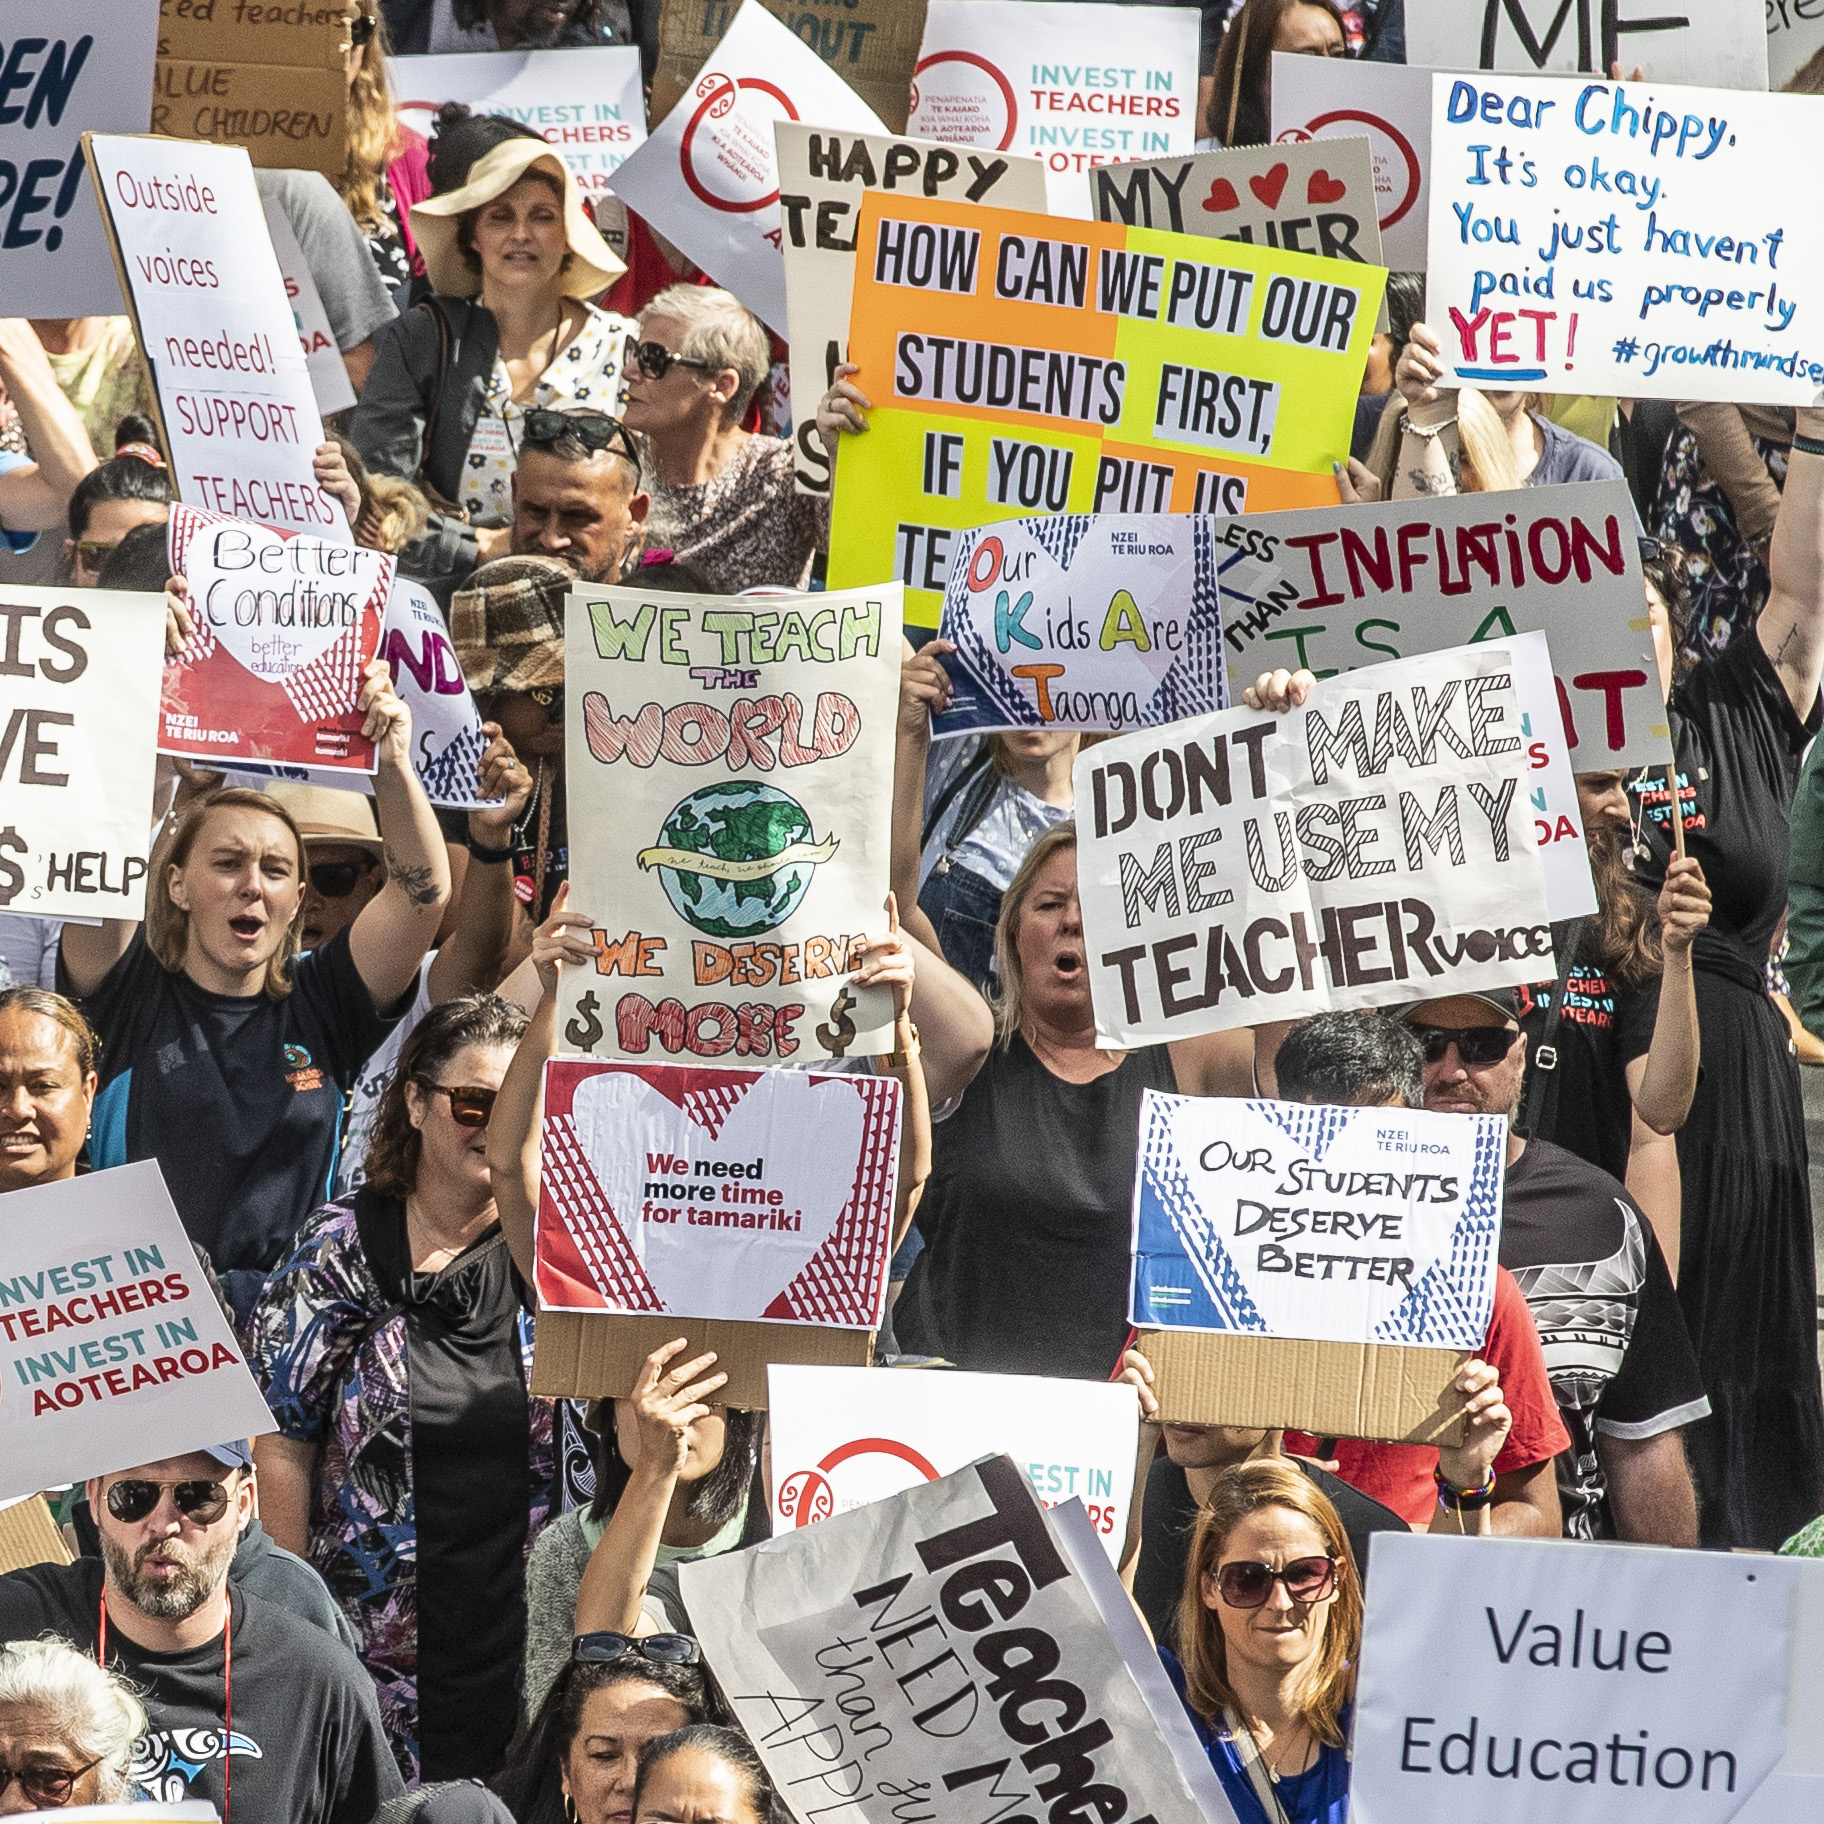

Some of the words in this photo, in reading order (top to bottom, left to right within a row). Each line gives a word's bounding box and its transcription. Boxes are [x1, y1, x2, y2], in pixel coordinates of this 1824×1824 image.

[1447, 80, 1555, 128] Dear
[1466, 143, 1538, 190] It's
[1453, 205, 1521, 248] You
[1540, 211, 1622, 261] just
[1642, 207, 1783, 270] haven't
[1472, 267, 1555, 315] paid
[1575, 274, 1615, 300] us
[1638, 281, 1797, 336] properly
[1449, 307, 1579, 370] YET!
[213, 528, 369, 576] Better
[965, 536, 1037, 593] Our
[208, 578, 357, 630] Conditions
[993, 589, 1091, 652] Kids
[1098, 591, 1180, 650] Are
[251, 638, 303, 658] better
[251, 658, 303, 677] education
[1011, 664, 1141, 724] Taonga
[1201, 1142, 1275, 1174] OUR
[1377, 1130, 1408, 1142] NZEI
[1377, 1142, 1394, 1155] TE
[1396, 1142, 1420, 1155] RIU
[1422, 1142, 1450, 1155] ROA
[646, 1153, 688, 1174] We
[694, 1157, 763, 1179] need
[1276, 1160, 1459, 1203] STUDENTS
[644, 1179, 715, 1201] more
[721, 1183, 783, 1206] time
[642, 1203, 681, 1223] for
[687, 1204, 801, 1232] tamariki
[1234, 1200, 1402, 1241] DESERVE
[1257, 1243, 1414, 1293] BETTER
[1485, 1607, 1673, 1675] Value
[1401, 1716, 1738, 1794] Education
